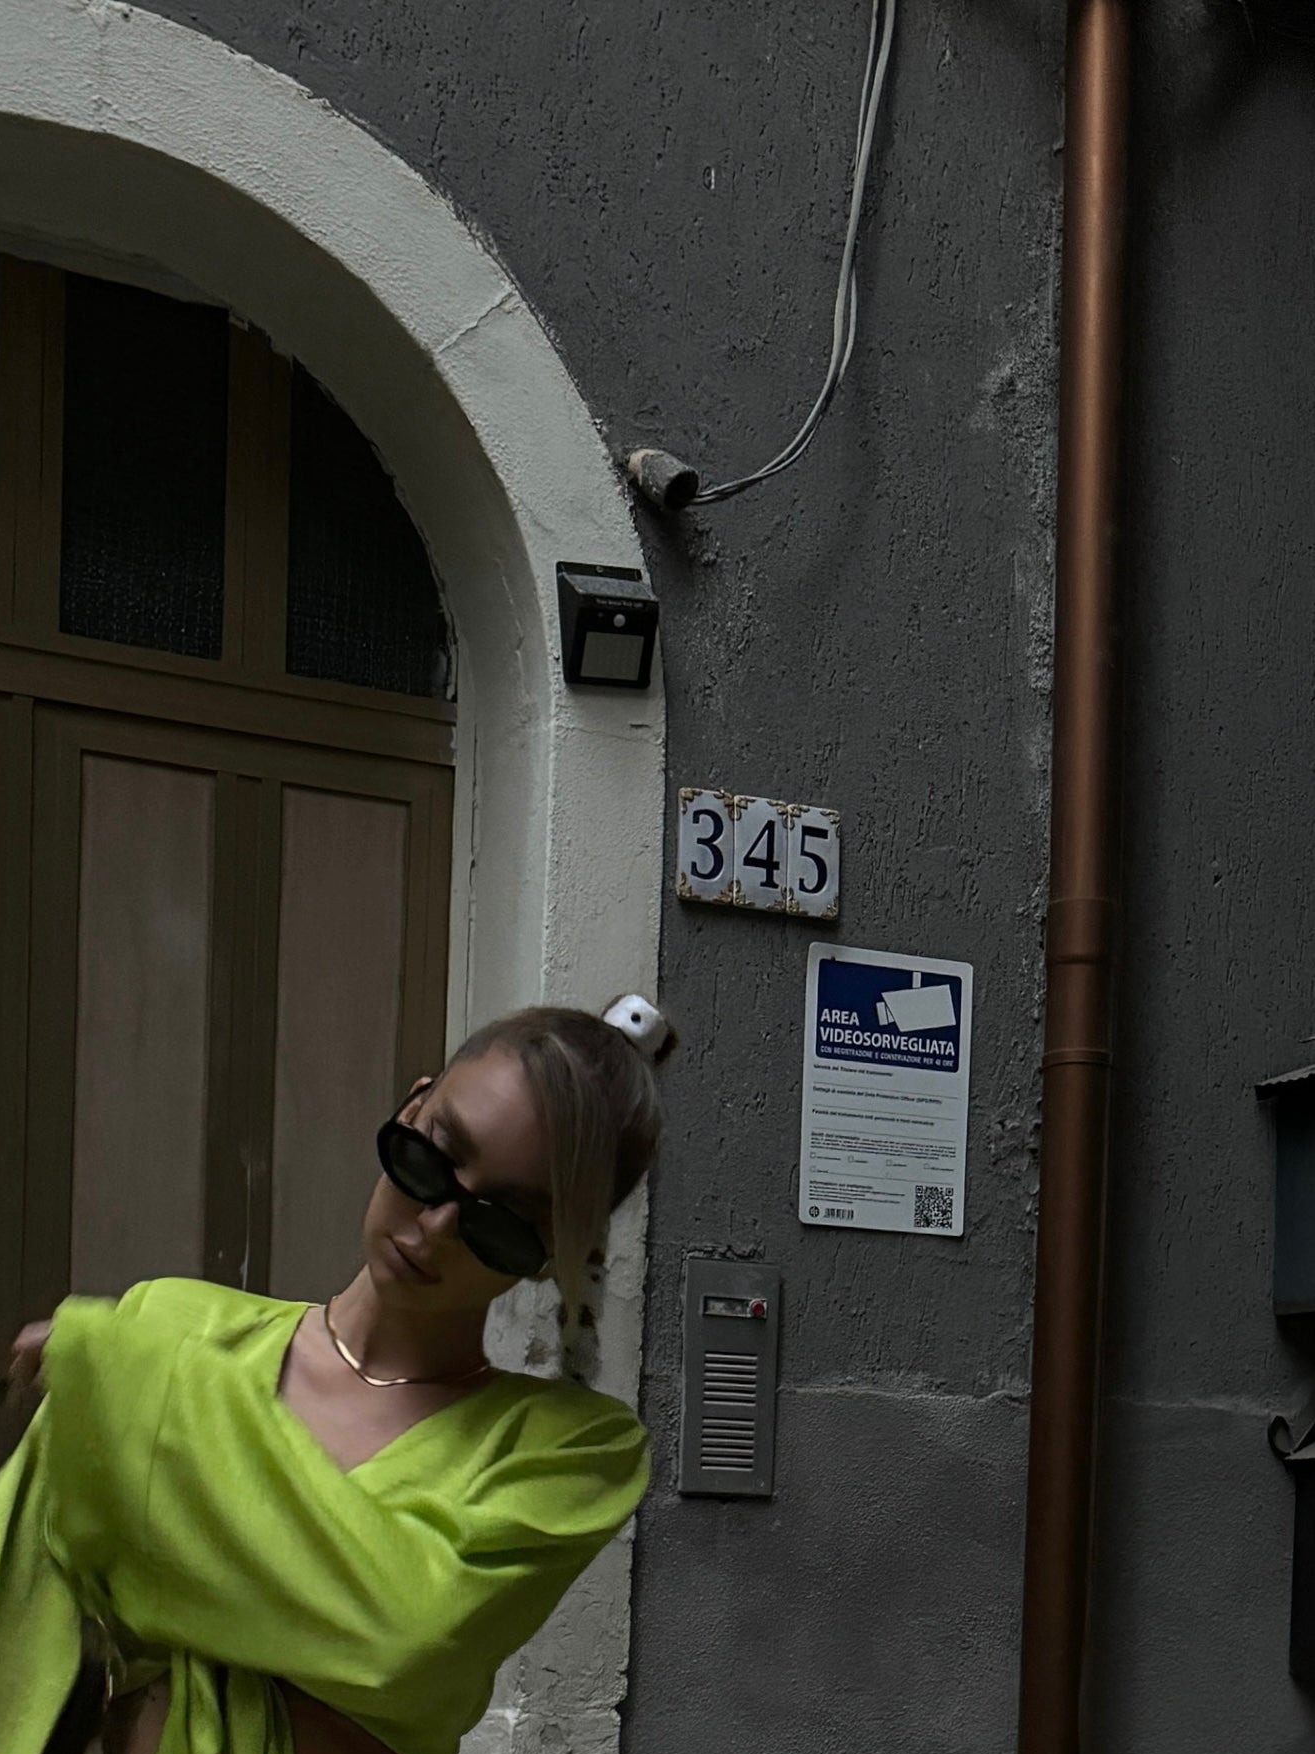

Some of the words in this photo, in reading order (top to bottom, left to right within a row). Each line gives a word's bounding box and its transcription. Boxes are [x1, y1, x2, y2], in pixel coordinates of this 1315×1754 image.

[690, 808, 829, 895] 345
[820, 1008, 860, 1027] AREA
[820, 1026, 956, 1057] VIDEOSORVEGLIATA
